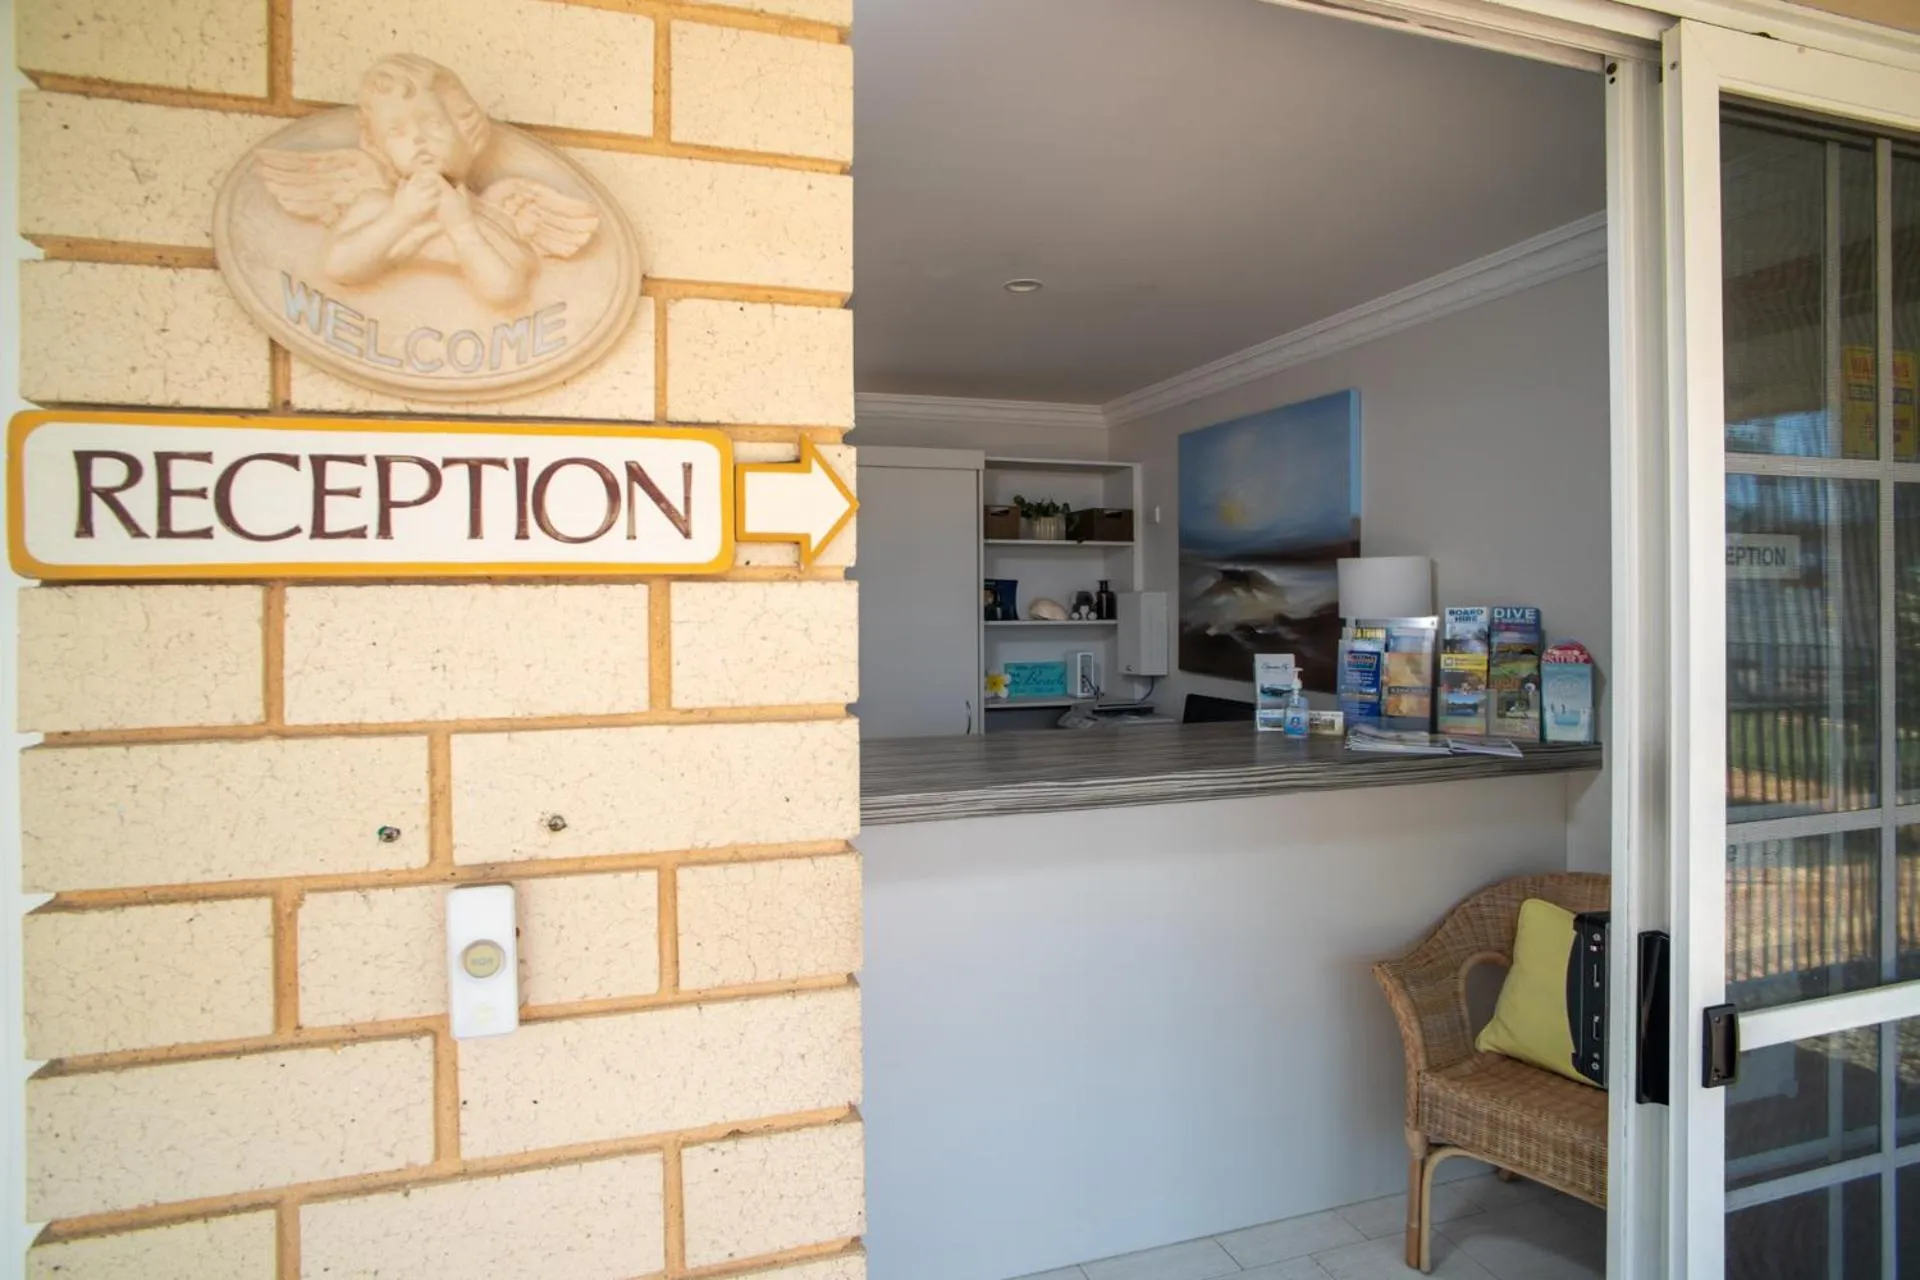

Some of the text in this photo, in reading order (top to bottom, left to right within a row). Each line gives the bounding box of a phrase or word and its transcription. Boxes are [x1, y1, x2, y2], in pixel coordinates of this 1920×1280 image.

[281, 270, 568, 373] WELCOME
[72, 449, 695, 544] RECEPTION
[1494, 608, 1537, 620] DIVE
